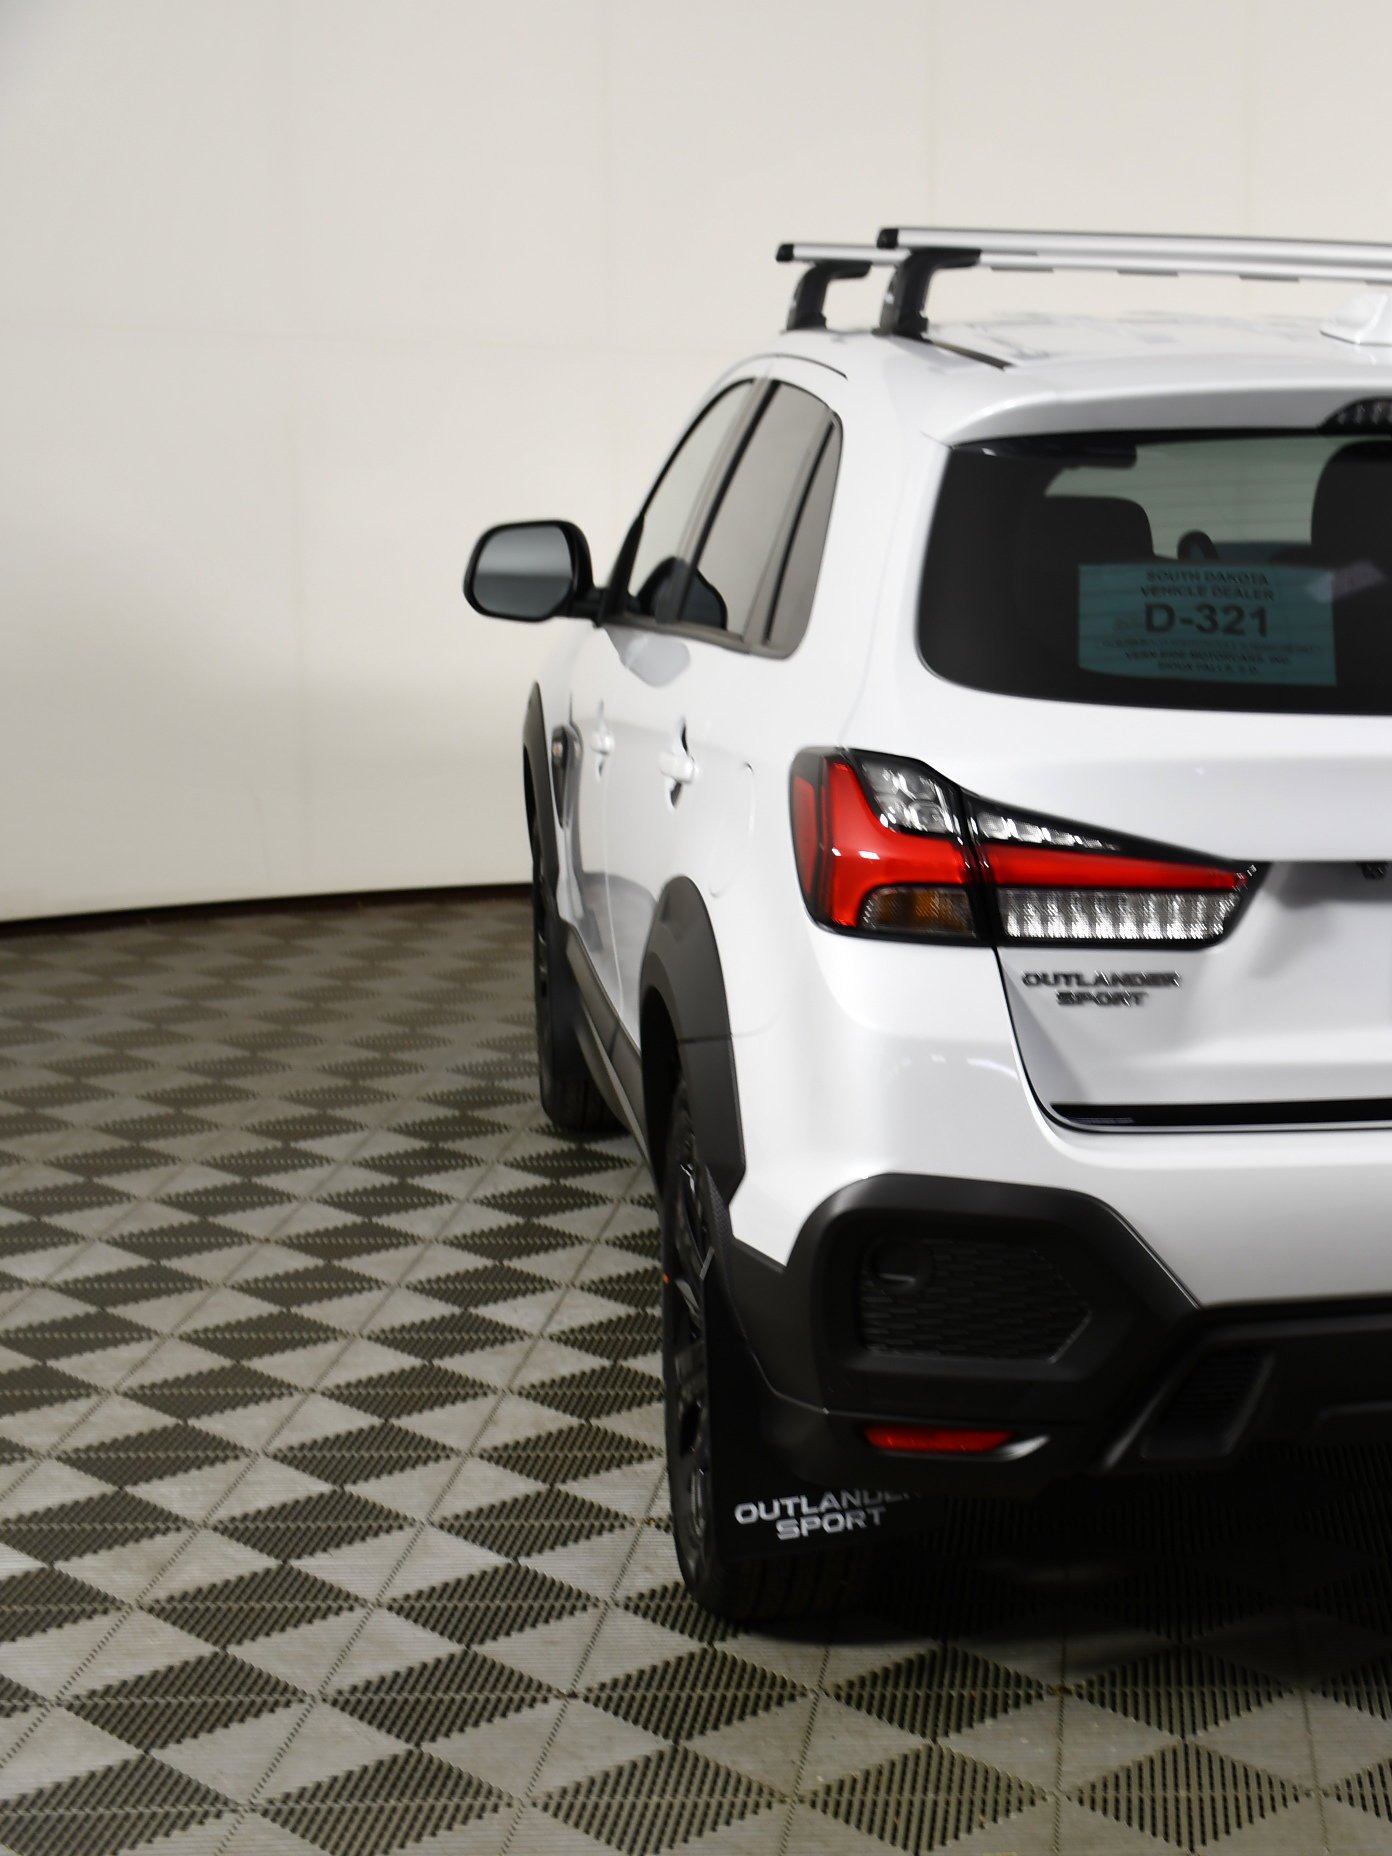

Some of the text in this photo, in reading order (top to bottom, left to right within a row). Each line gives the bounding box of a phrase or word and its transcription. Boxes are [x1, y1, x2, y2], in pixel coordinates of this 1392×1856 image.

[1145, 569, 1269, 585] SOUTH DAKOTA
[1140, 585, 1275, 601] VEHICLE DEALER
[1144, 603, 1268, 638] D-321
[1021, 971, 1182, 987] OUTLANDER
[1055, 990, 1149, 1007] SPORT
[733, 1488, 921, 1525] OUTLAND
[775, 1506, 886, 1541] SPORT
